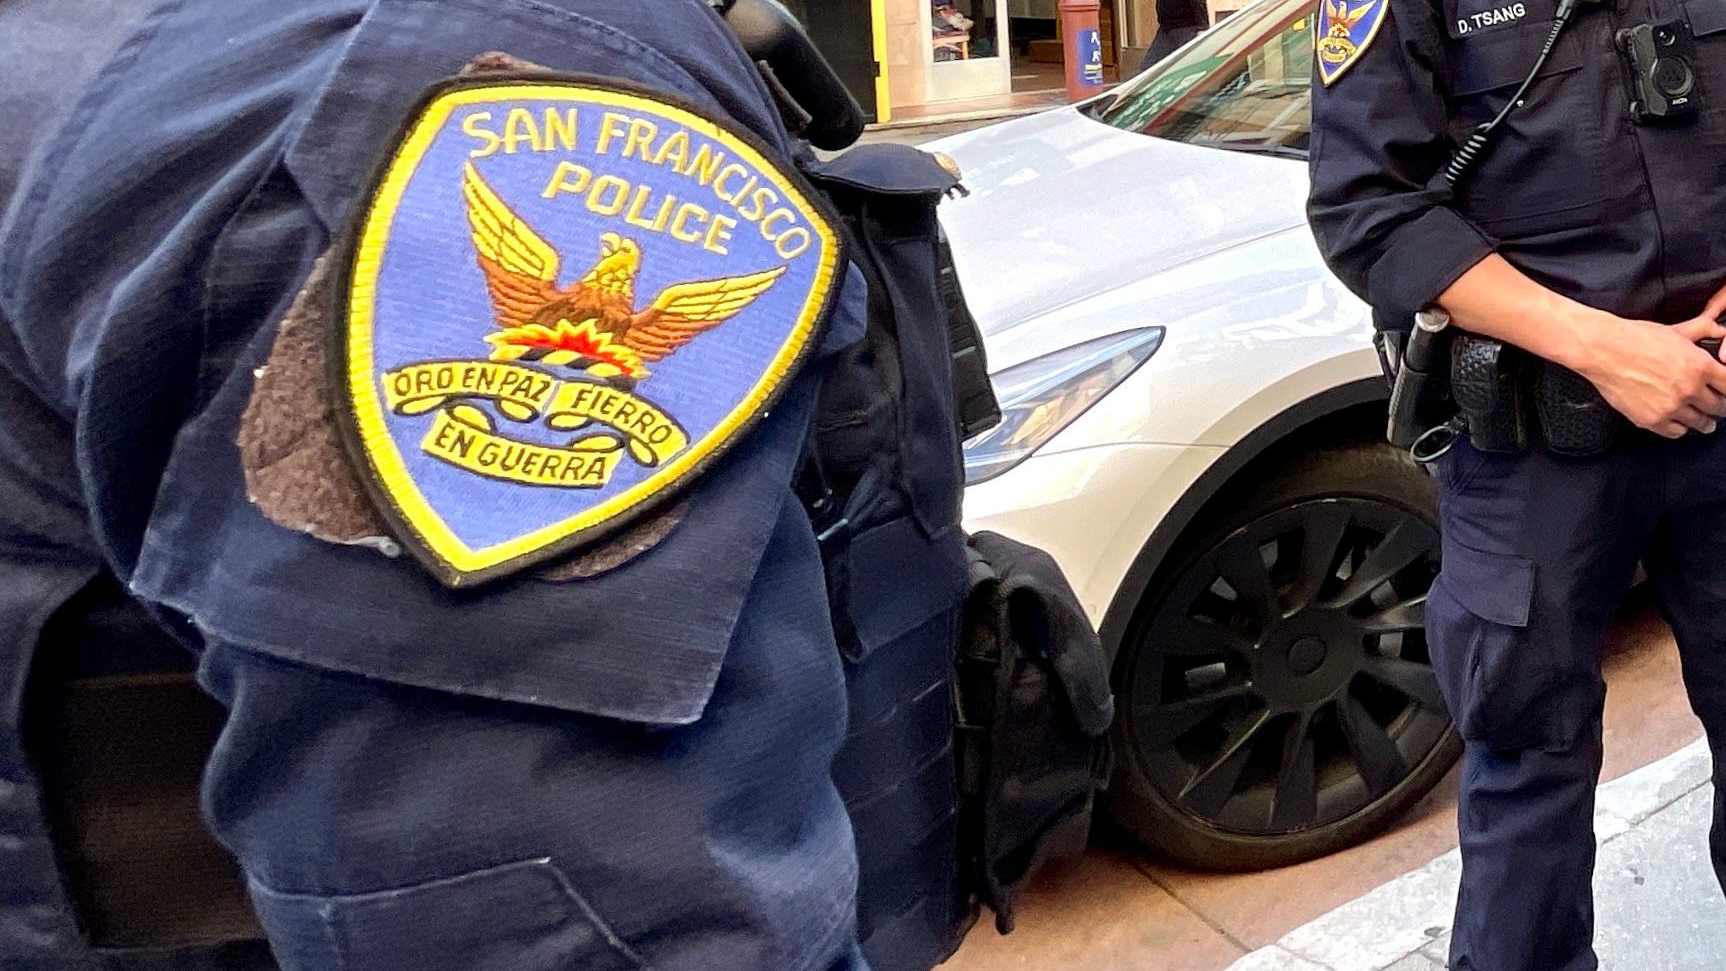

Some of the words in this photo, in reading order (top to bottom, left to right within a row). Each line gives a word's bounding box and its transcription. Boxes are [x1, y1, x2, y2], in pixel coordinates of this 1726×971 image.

[1458, 19, 1473, 34] D.
[1471, 2, 1526, 29] TSANG
[462, 107, 578, 159] SAN
[596, 112, 812, 260] FRANCISCO
[541, 160, 738, 256] POLICE
[393, 366, 454, 397] ORO
[462, 366, 496, 390] EN
[500, 370, 552, 402] PAZ
[574, 388, 674, 446] FIERRO
[433, 425, 473, 457] EN
[478, 436, 608, 482] GUERRA
